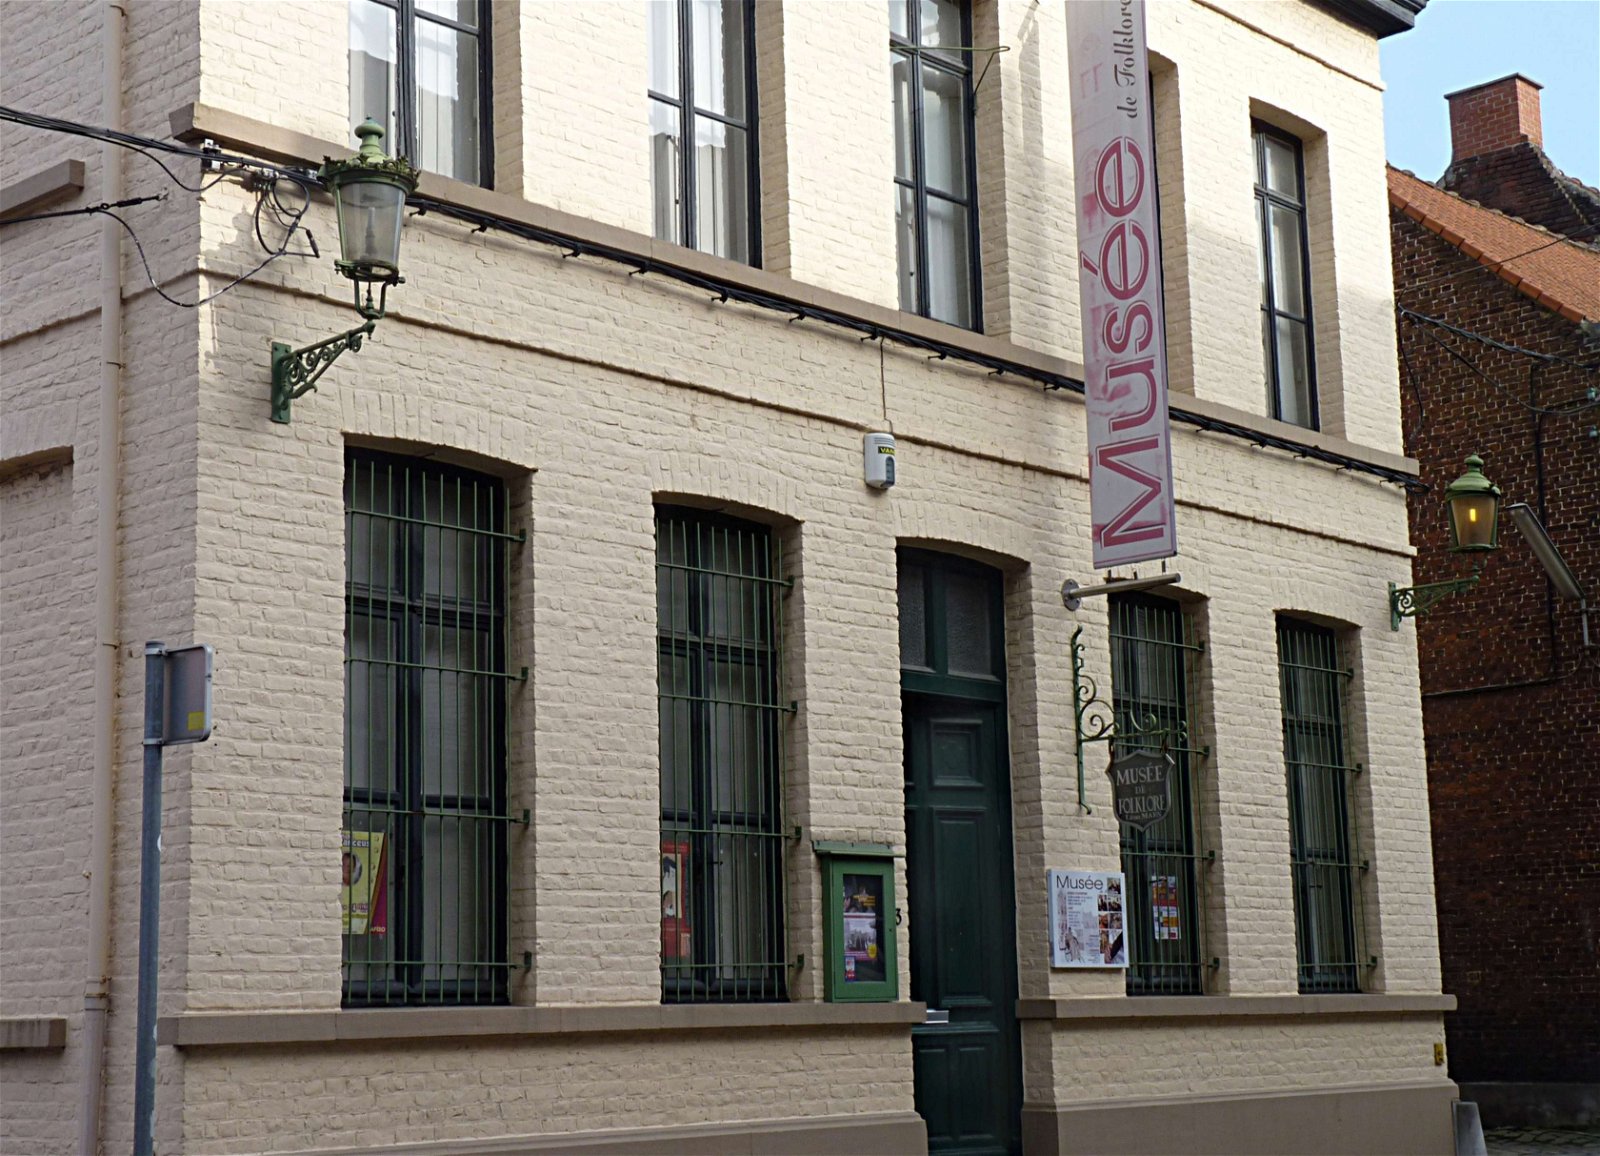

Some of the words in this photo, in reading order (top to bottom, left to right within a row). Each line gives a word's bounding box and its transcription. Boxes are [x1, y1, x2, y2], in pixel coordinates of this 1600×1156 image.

[1117, 96, 1138, 119] de
[1080, 135, 1166, 550] Musée
[1116, 762, 1164, 786] MUSÉE
[1135, 784, 1146, 794] DE
[1118, 794, 1166, 814] FOLKLORE
[1056, 875, 1104, 890] Musée
